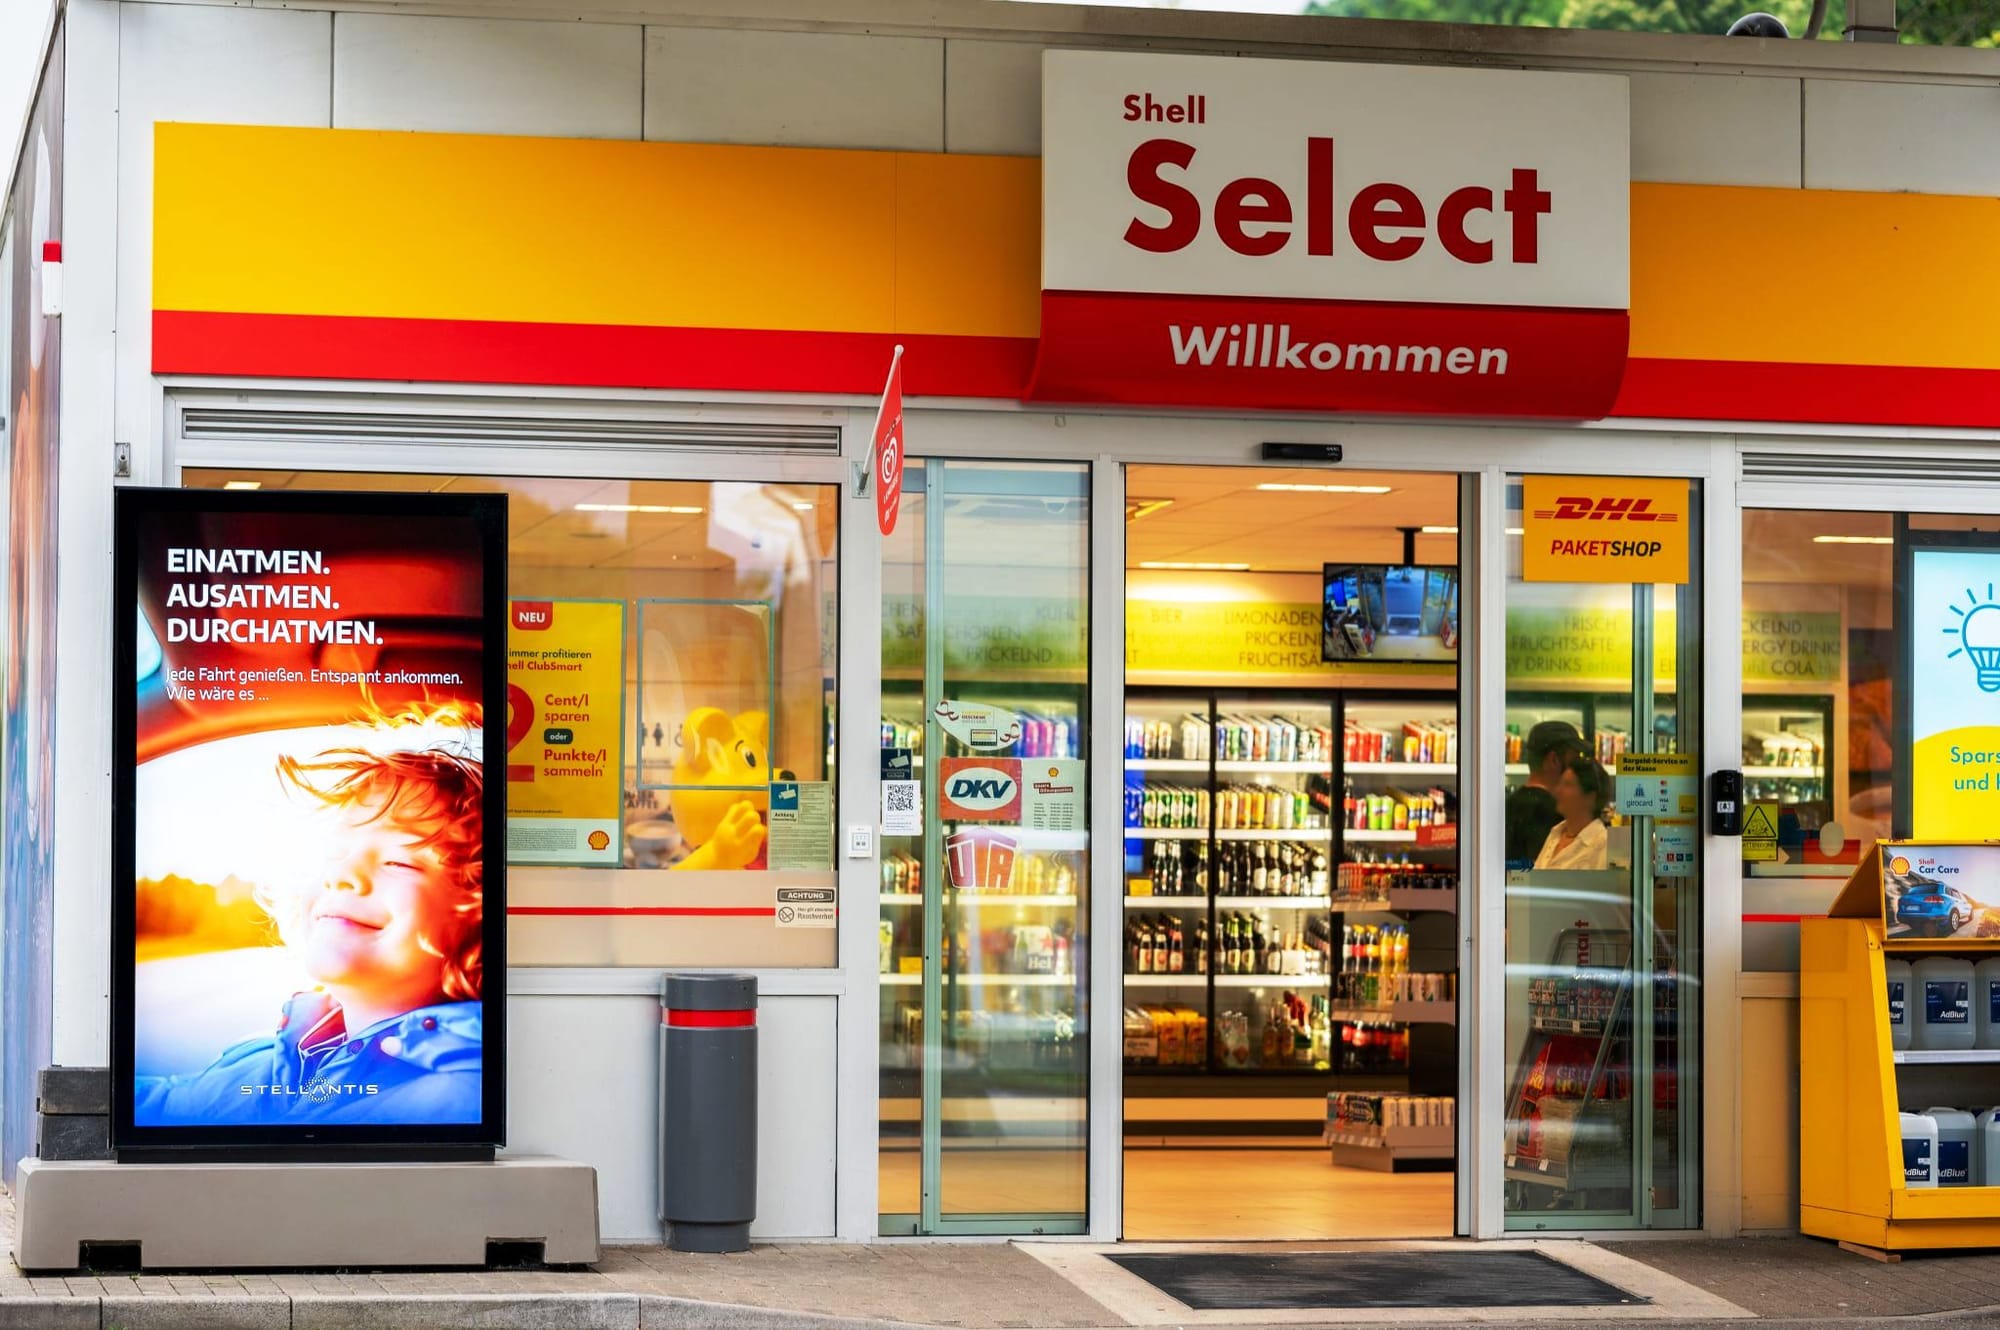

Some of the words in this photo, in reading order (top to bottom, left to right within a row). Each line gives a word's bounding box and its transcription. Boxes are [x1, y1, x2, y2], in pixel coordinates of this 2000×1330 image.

[1123, 93, 1206, 124] Shell
[1123, 136, 1552, 264] Select
[1169, 323, 1508, 375] Willkommen
[1554, 496, 1658, 521] DHL
[1550, 539, 1661, 557] PAKETSHOP
[167, 548, 331, 575] EINATMEN.
[166, 583, 340, 610] AUSATMEN.
[518, 611, 546, 623] NEU
[167, 617, 384, 646] DURCHATMEN.
[542, 648, 592, 660] profitieren
[527, 661, 583, 672] ClubSmart
[166, 667, 195, 683] Jede
[199, 667, 236, 682] Fahrt
[238, 667, 307, 685] genießen.
[311, 669, 381, 685] Entspannt
[384, 669, 464, 685] ankommen.
[166, 686, 196, 701] Wie
[199, 686, 236, 701] wäre
[238, 689, 255, 701] es
[544, 712, 590, 725] sparen
[549, 732, 568, 741] oder
[950, 779, 1012, 798] DKV
[1954, 772, 1989, 790] und
[1918, 865, 1935, 874] Car
[1937, 866, 1959, 874] Care
[240, 1084, 379, 1095] STELLANTIS
